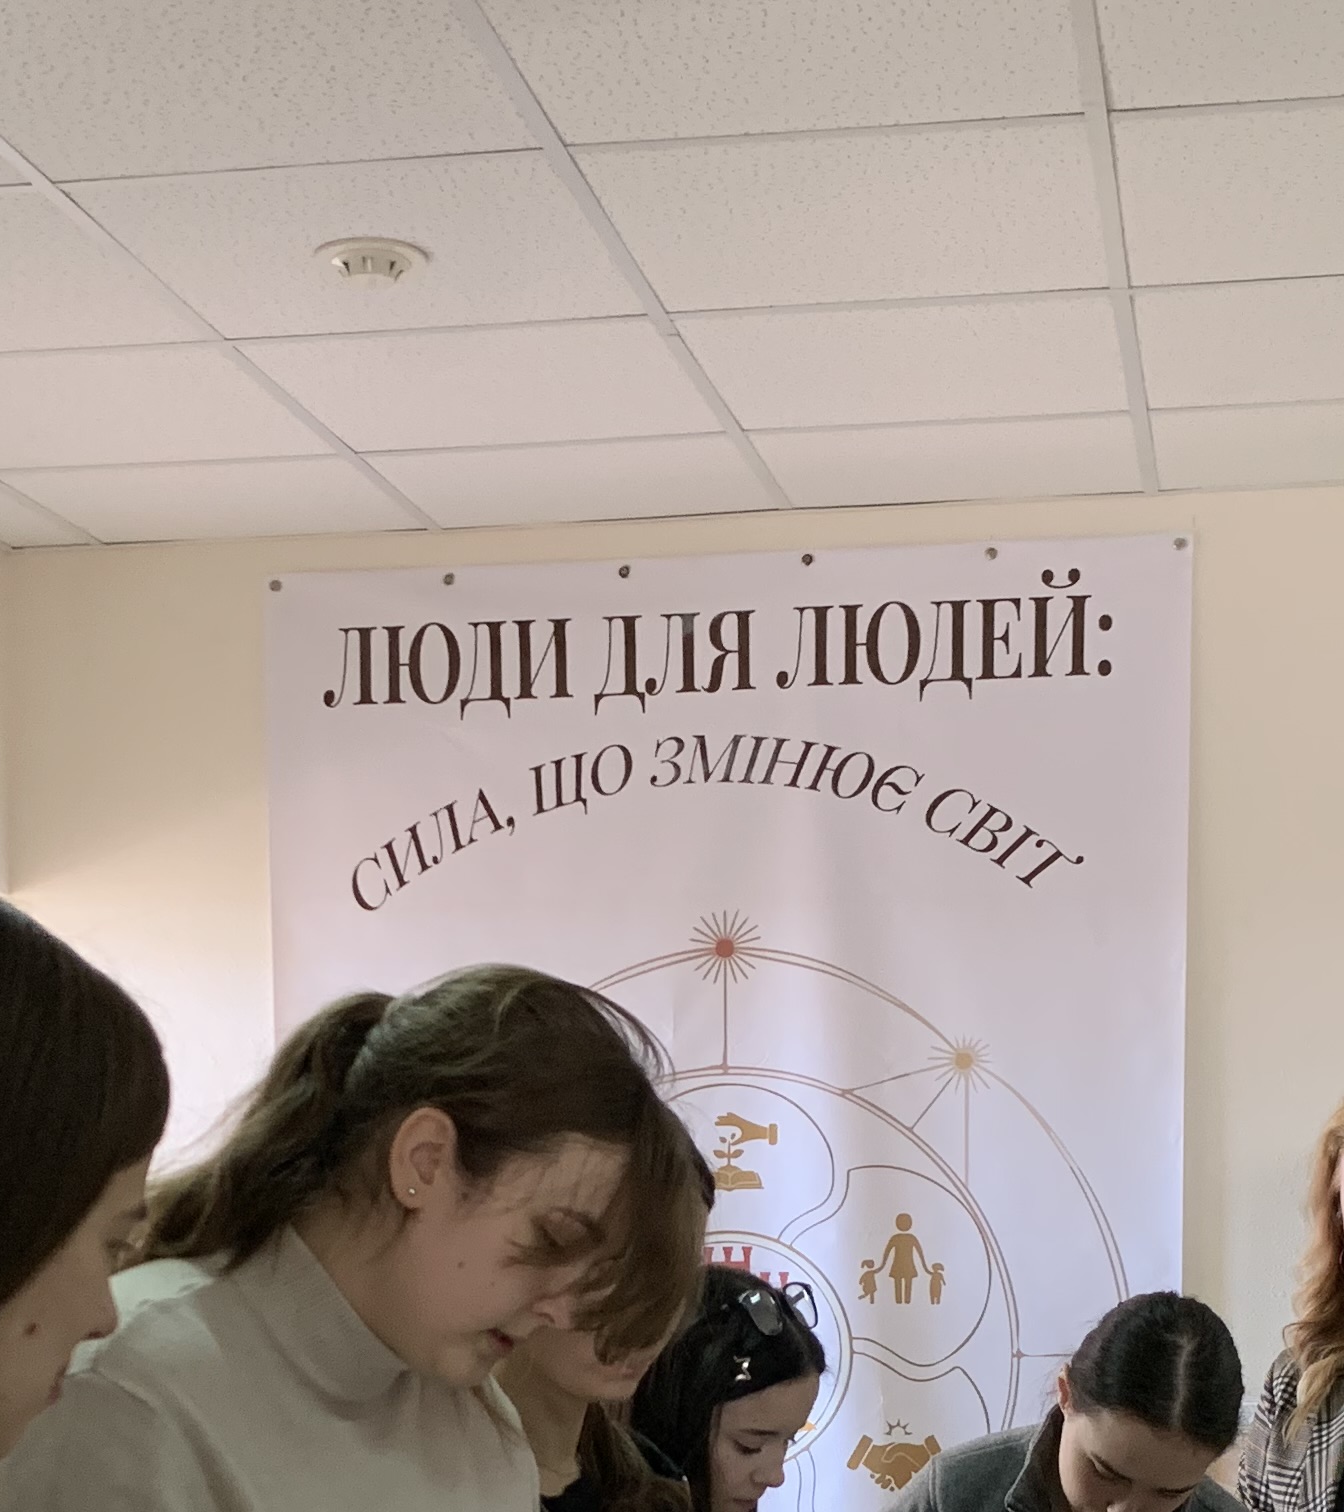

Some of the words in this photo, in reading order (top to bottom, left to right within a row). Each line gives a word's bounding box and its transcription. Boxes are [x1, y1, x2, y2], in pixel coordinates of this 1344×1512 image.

[323, 617, 574, 721] ЛЮДИ
[593, 609, 757, 716] ДЛЯ
[775, 567, 1113, 702] ЛЮДЕЙ:
[350, 788, 517, 912] СИЛА,
[529, 744, 633, 816] ЩО
[649, 733, 926, 815] ЗМІНЮЄ
[925, 788, 1086, 889] СВІТ
